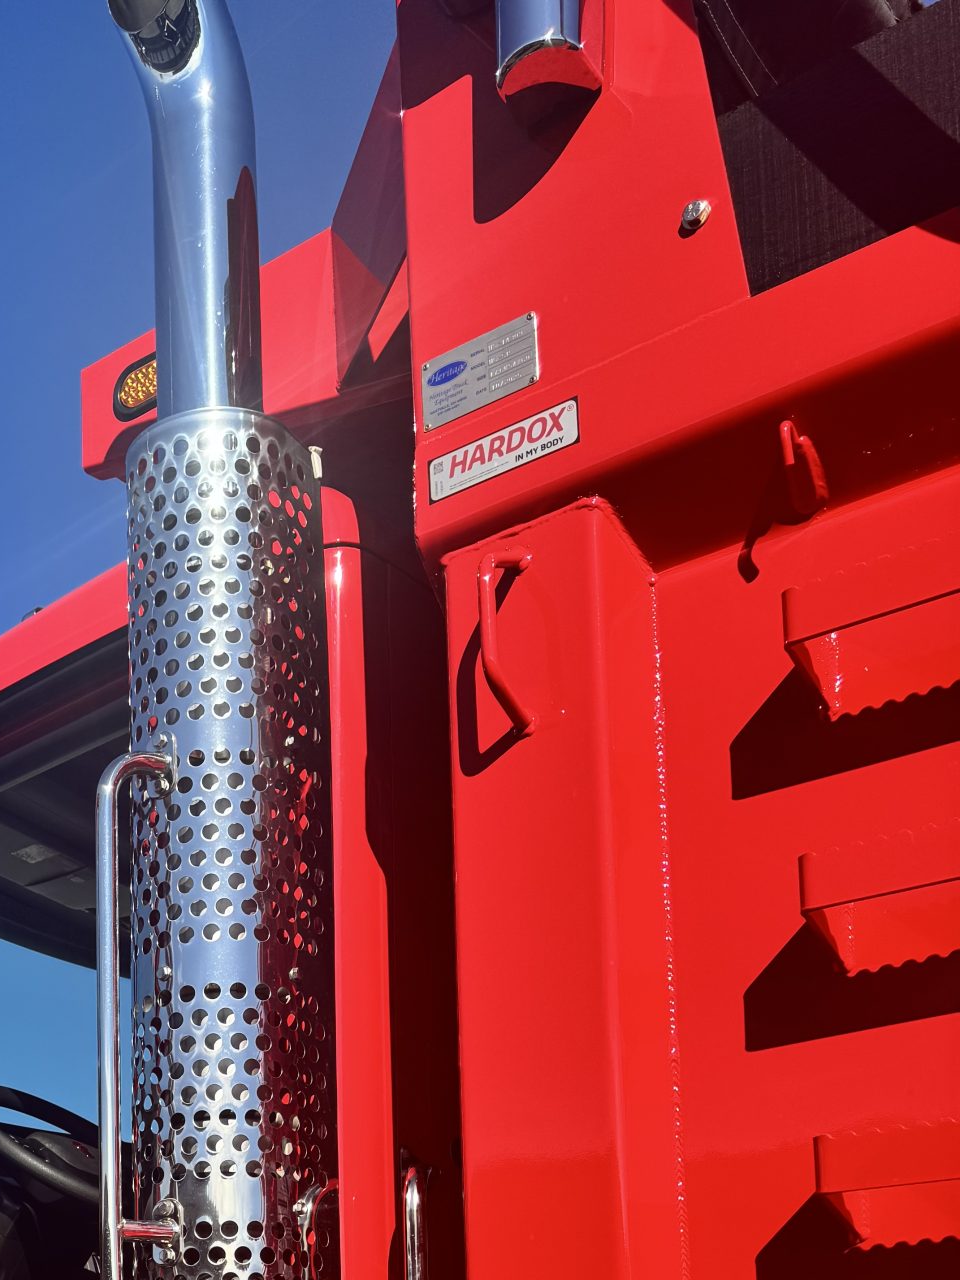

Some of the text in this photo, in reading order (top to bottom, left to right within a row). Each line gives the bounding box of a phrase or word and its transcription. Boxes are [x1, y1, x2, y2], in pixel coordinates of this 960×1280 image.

[429, 362, 466, 384] Heritage
[448, 406, 566, 479] HARDOX
[514, 435, 565, 463] IN MY BODY
